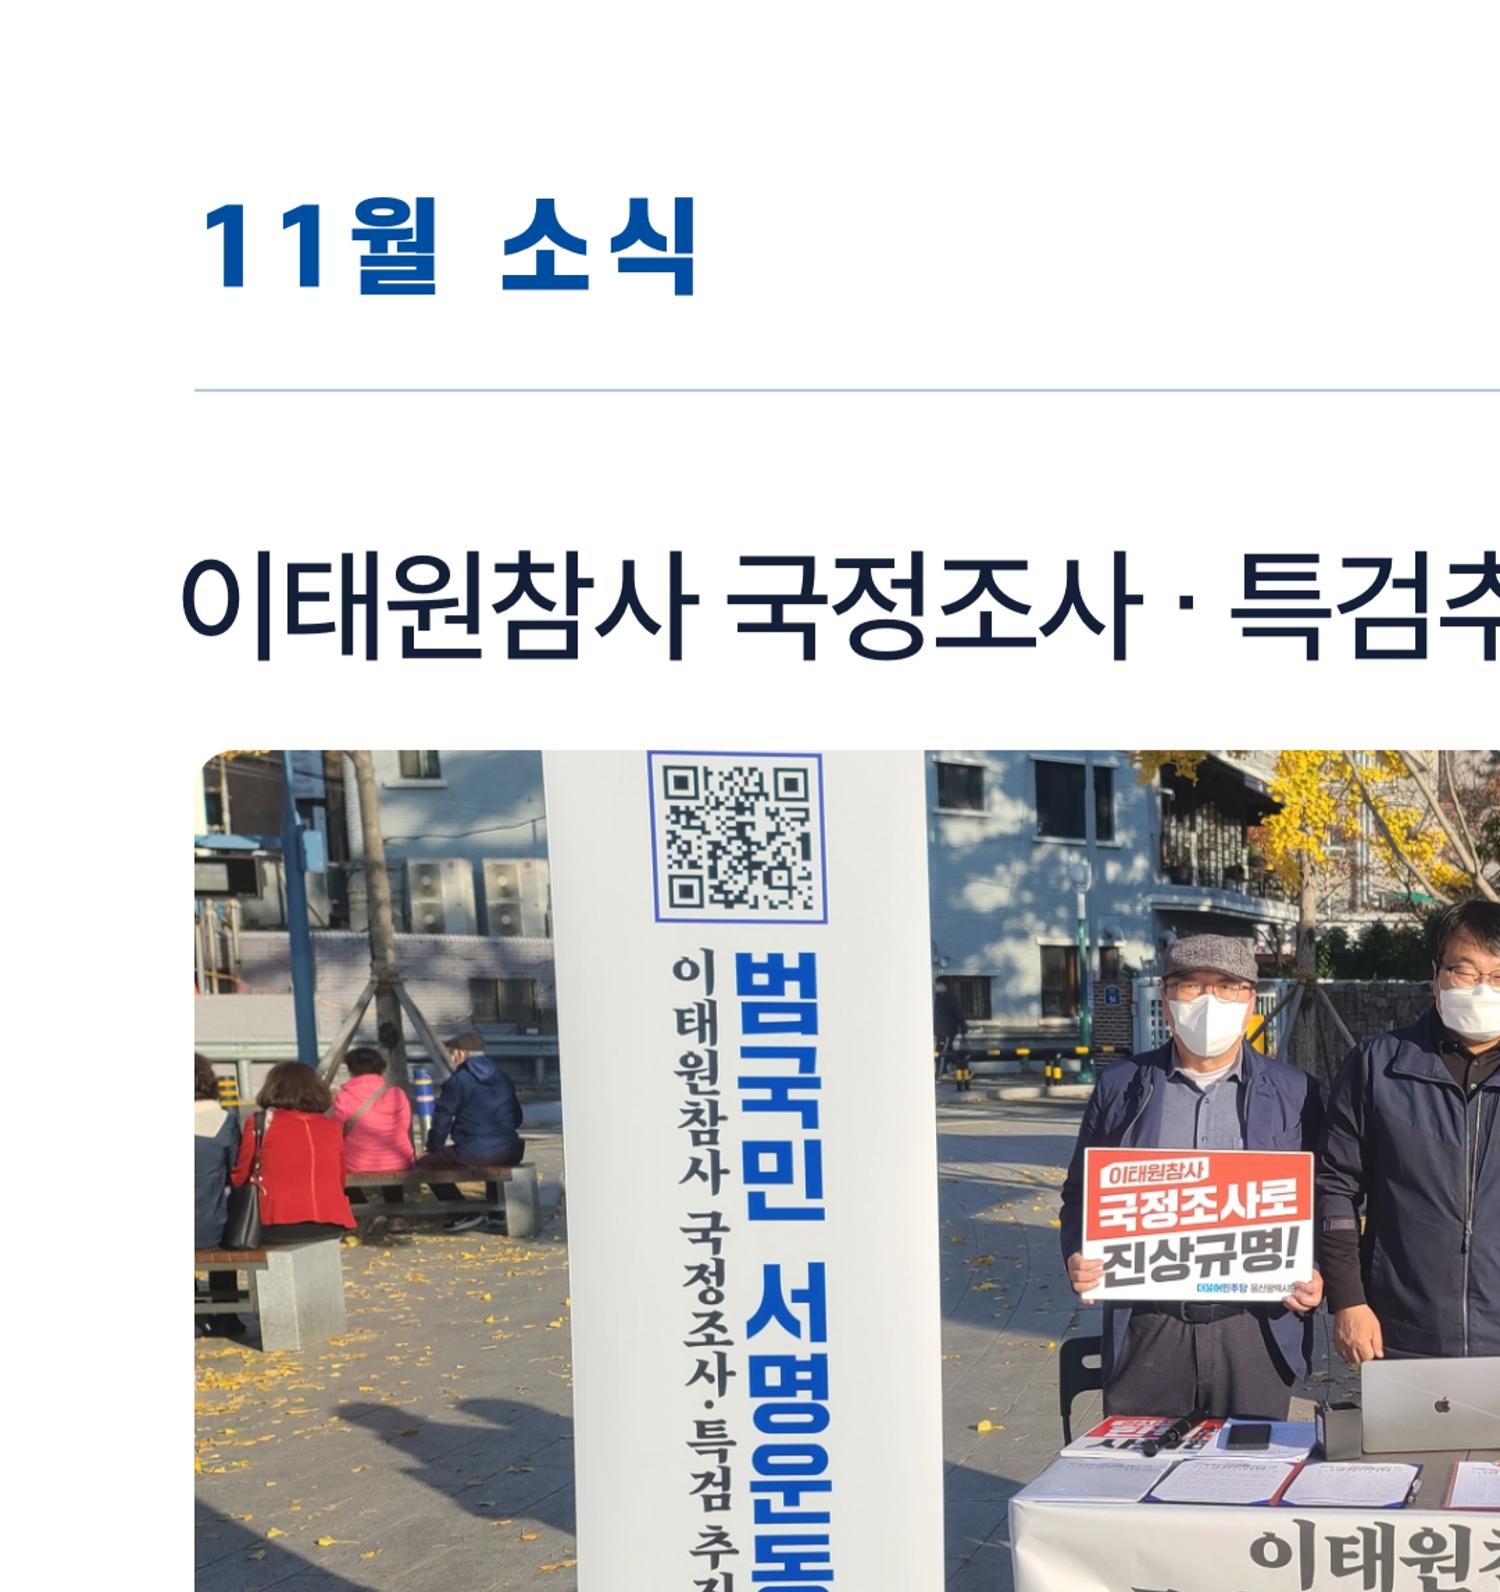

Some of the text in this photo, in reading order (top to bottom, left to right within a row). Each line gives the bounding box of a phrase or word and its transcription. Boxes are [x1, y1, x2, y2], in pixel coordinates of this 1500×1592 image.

[672, 946, 731, 1197] 이태원참사
[735, 951, 826, 1222] 범국민
[1098, 1177, 1299, 1232] 국정조사로
[1109, 1161, 1205, 1185] 이태원참사
[1102, 1225, 1301, 1289] 진상규명!
